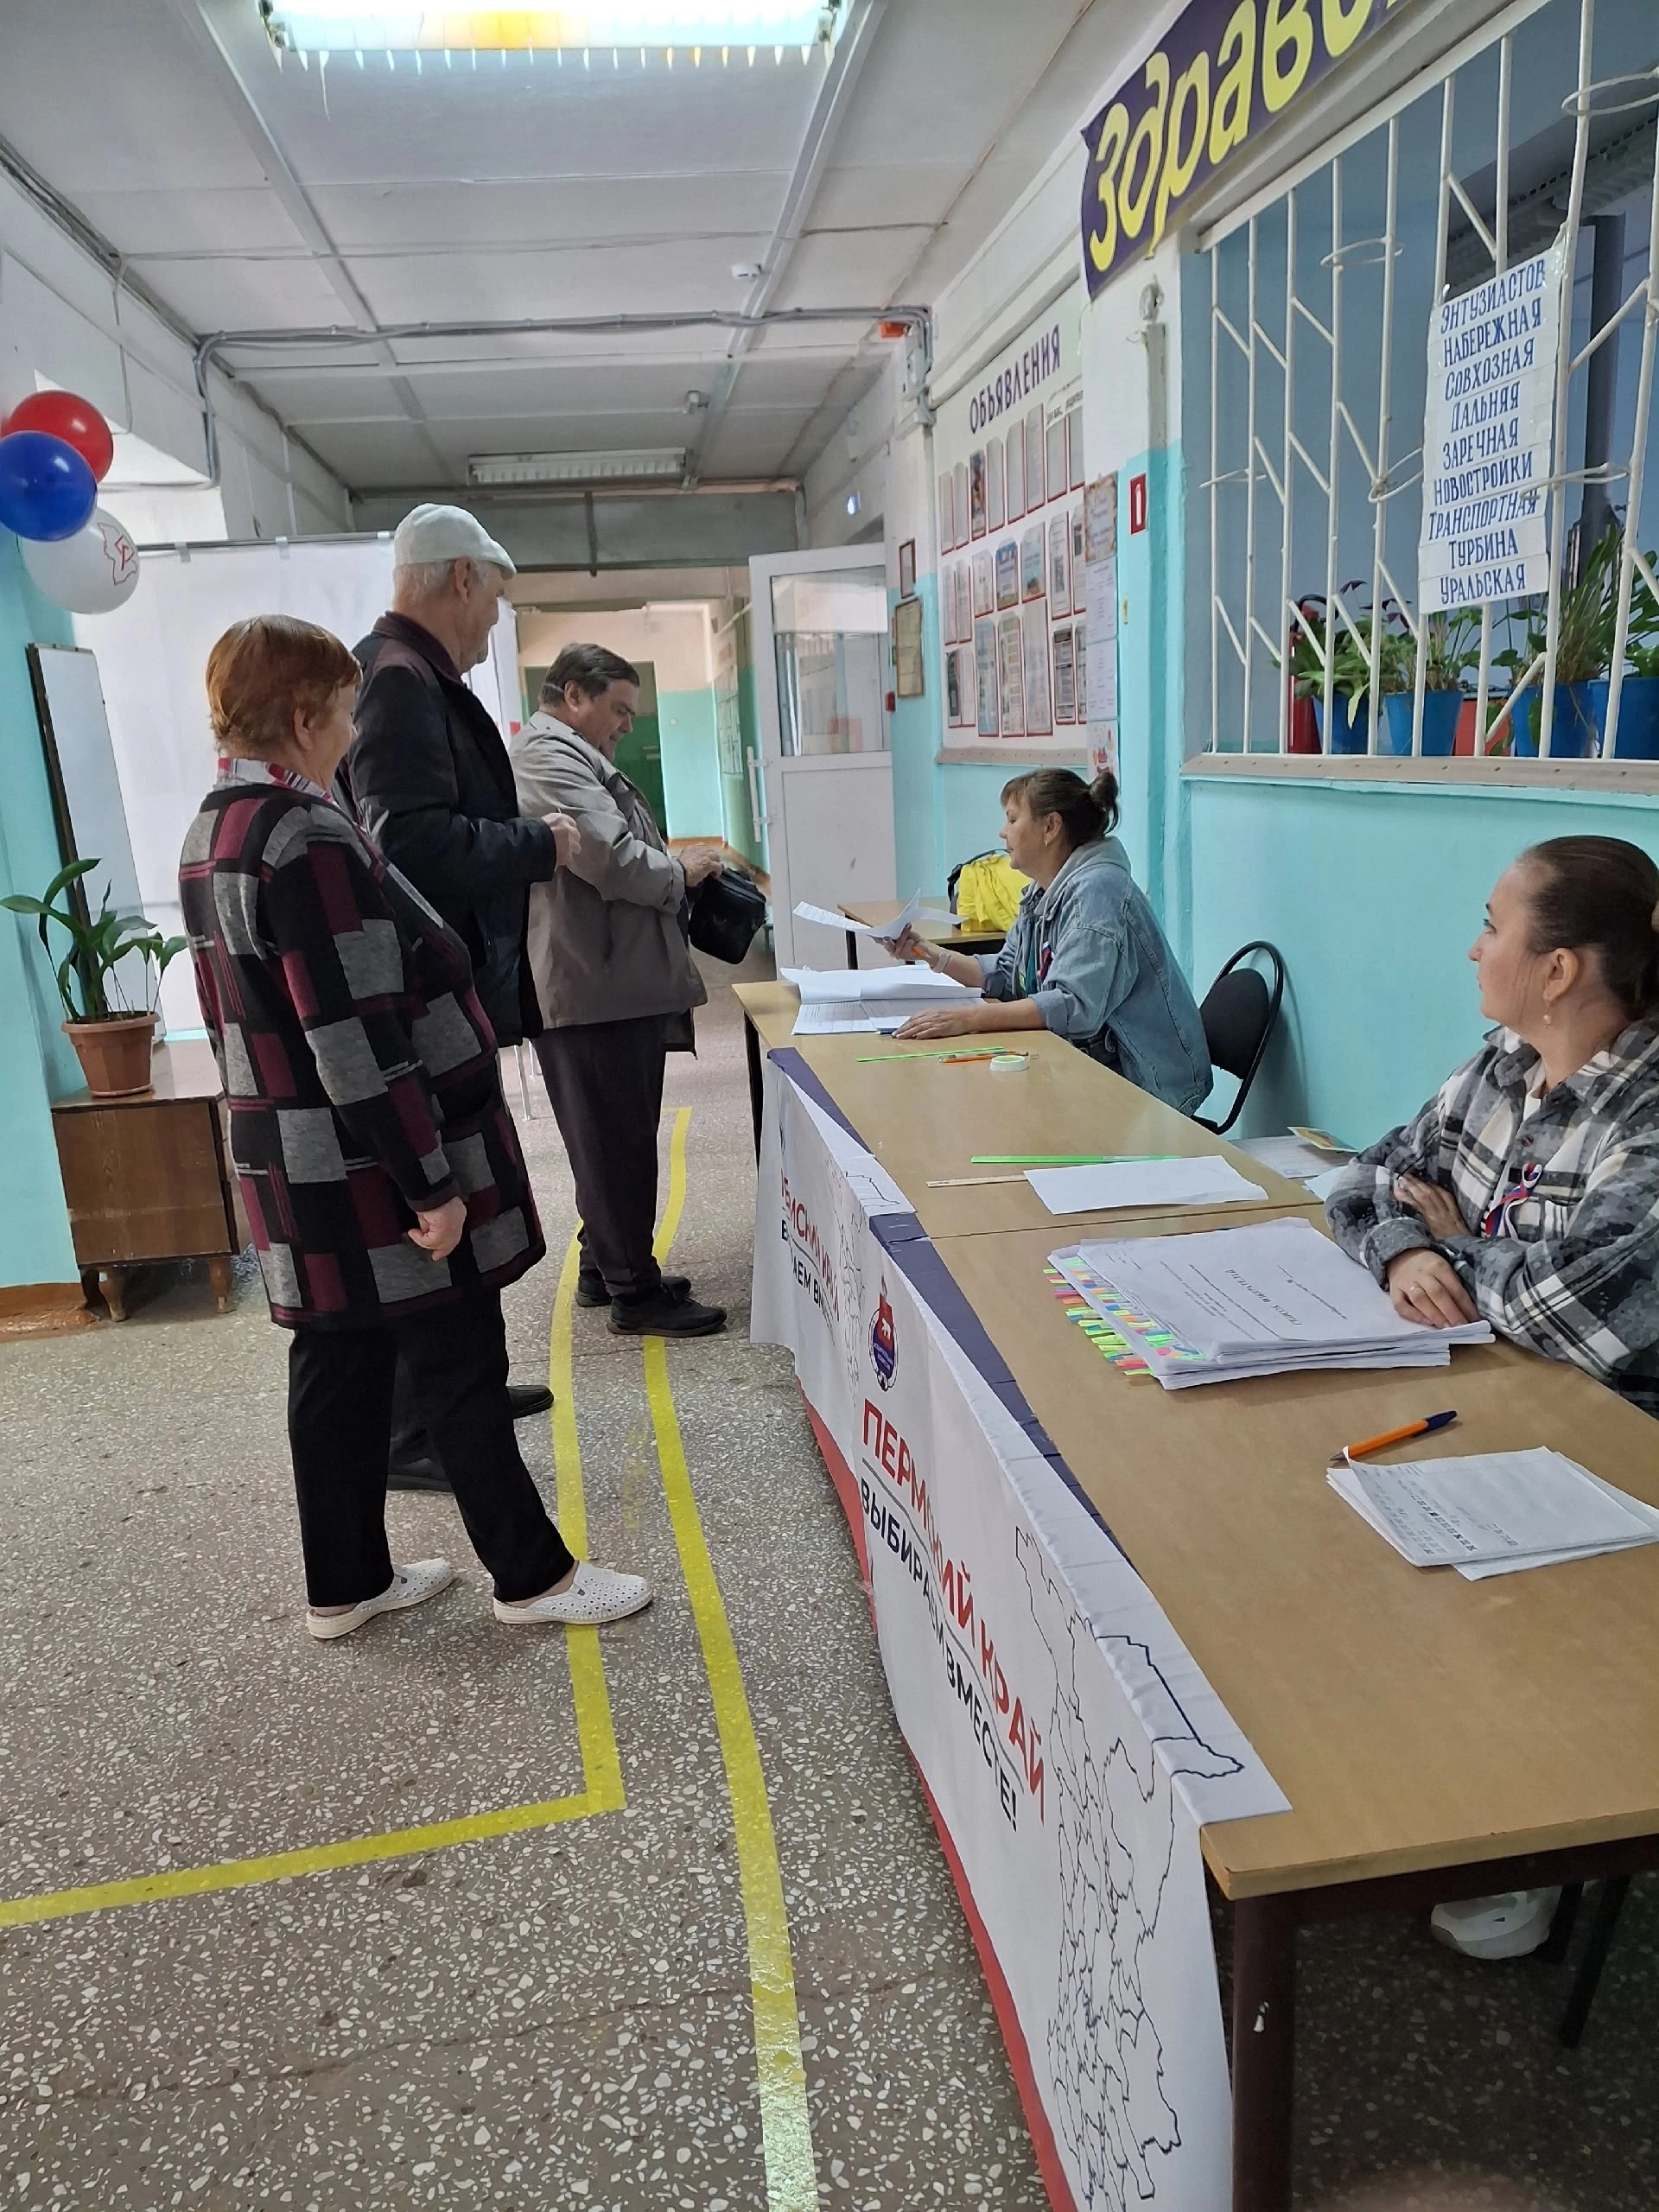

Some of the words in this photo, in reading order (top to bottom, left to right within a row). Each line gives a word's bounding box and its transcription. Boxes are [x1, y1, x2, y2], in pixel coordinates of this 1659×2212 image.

[1090, 0, 1399, 272] Здрав
[1440, 258, 1546, 334] ЭНТУЗИАСТОВ
[1444, 296, 1541, 367] НАБЕРЕЖНАЯ
[970, 322, 1060, 434] ОБЪЯВЛЕНИЯ
[1445, 336, 1535, 402] СОВХОЗНАЯ
[1451, 380, 1521, 433] ДАЛЬНЯЯ
[1442, 417, 1519, 470] ЗАРЕЧНАЯ
[1433, 450, 1533, 506] НОВОСТРОЙКИ
[1428, 488, 1538, 541] ТРАНСПОРТНАЯ
[1448, 528, 1519, 569] ТУРБИНА
[1440, 563, 1526, 605] УРАЛЬСКАЯ
[862, 1397, 976, 1649] ПЕРМСКИЙ
[980, 1618, 1045, 1827] КРАЙ
[861, 1477, 944, 1657] ВЫБИРАЕМ
[945, 1639, 1017, 1832] ВМЕСТЕ!
